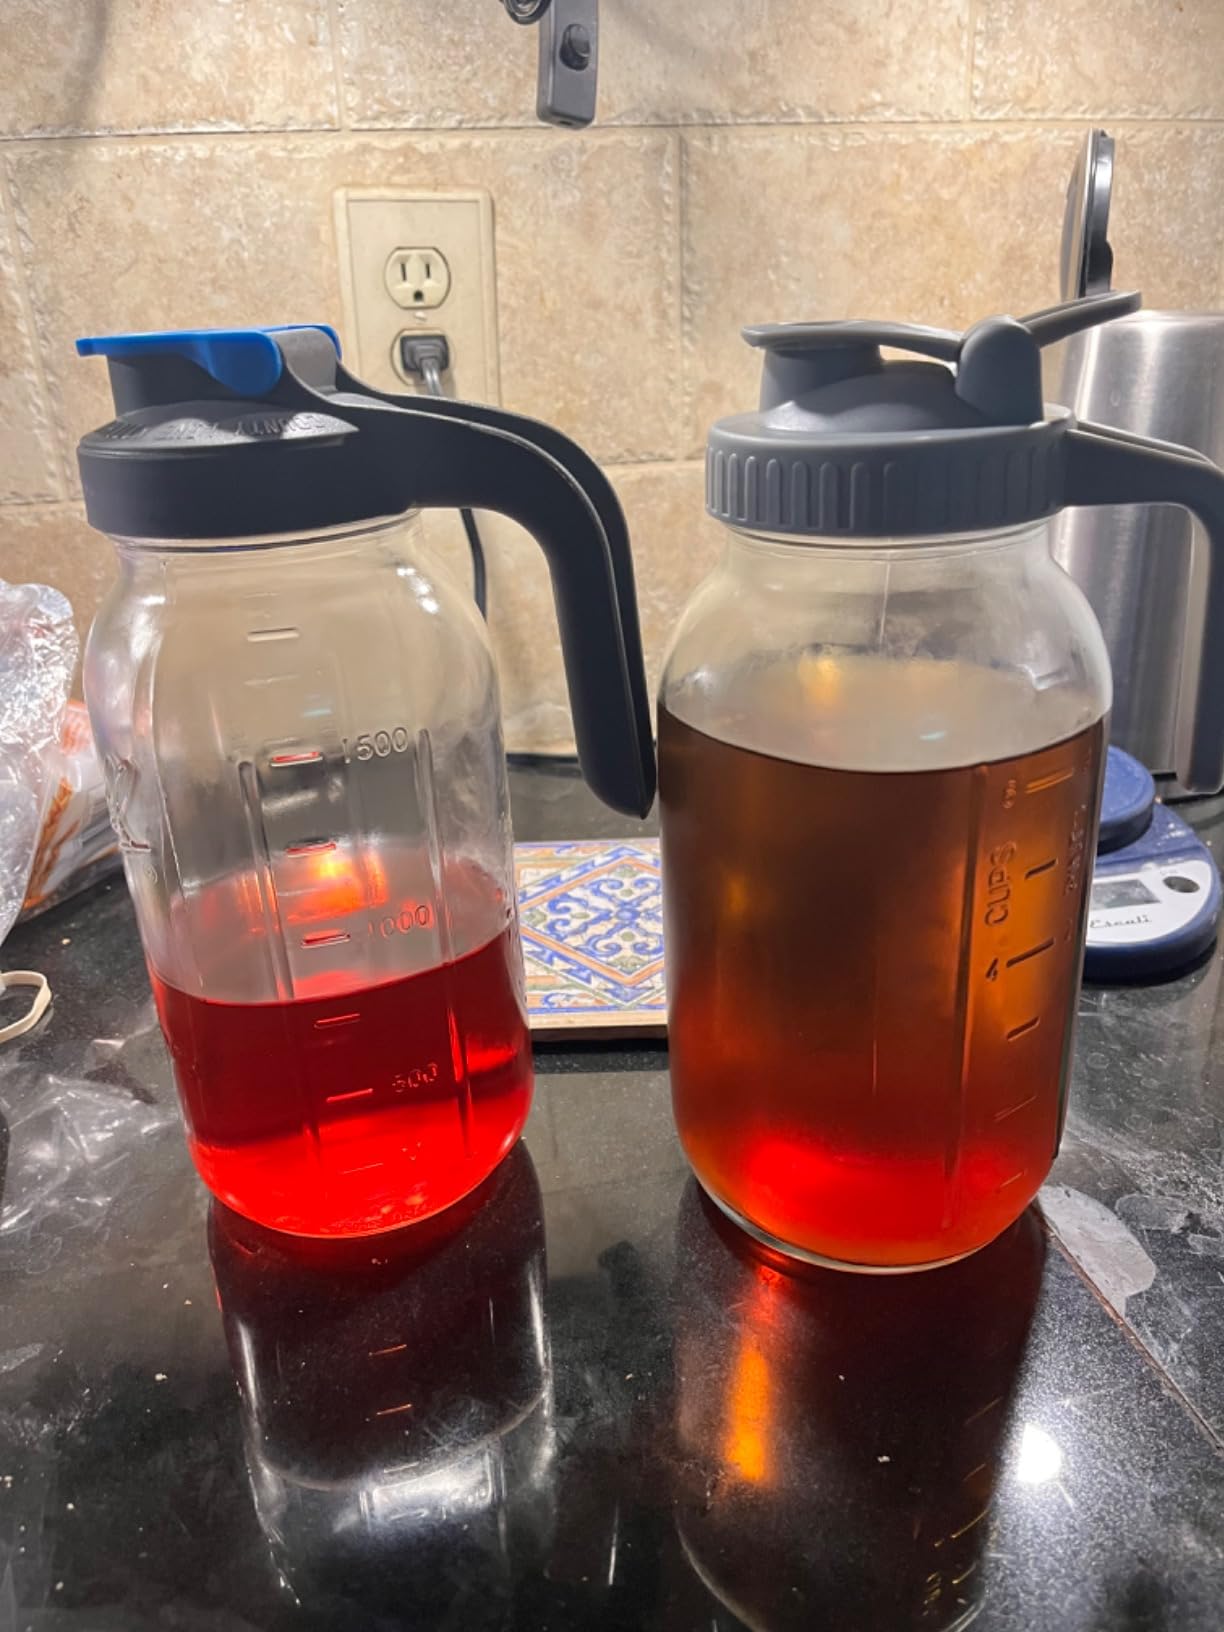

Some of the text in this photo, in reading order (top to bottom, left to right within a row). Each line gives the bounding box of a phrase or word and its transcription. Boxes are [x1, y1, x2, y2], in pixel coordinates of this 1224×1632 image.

[342, 726, 409, 764] 1500
[985, 841, 1018, 928] CUPS
[368, 904, 430, 940] 1000
